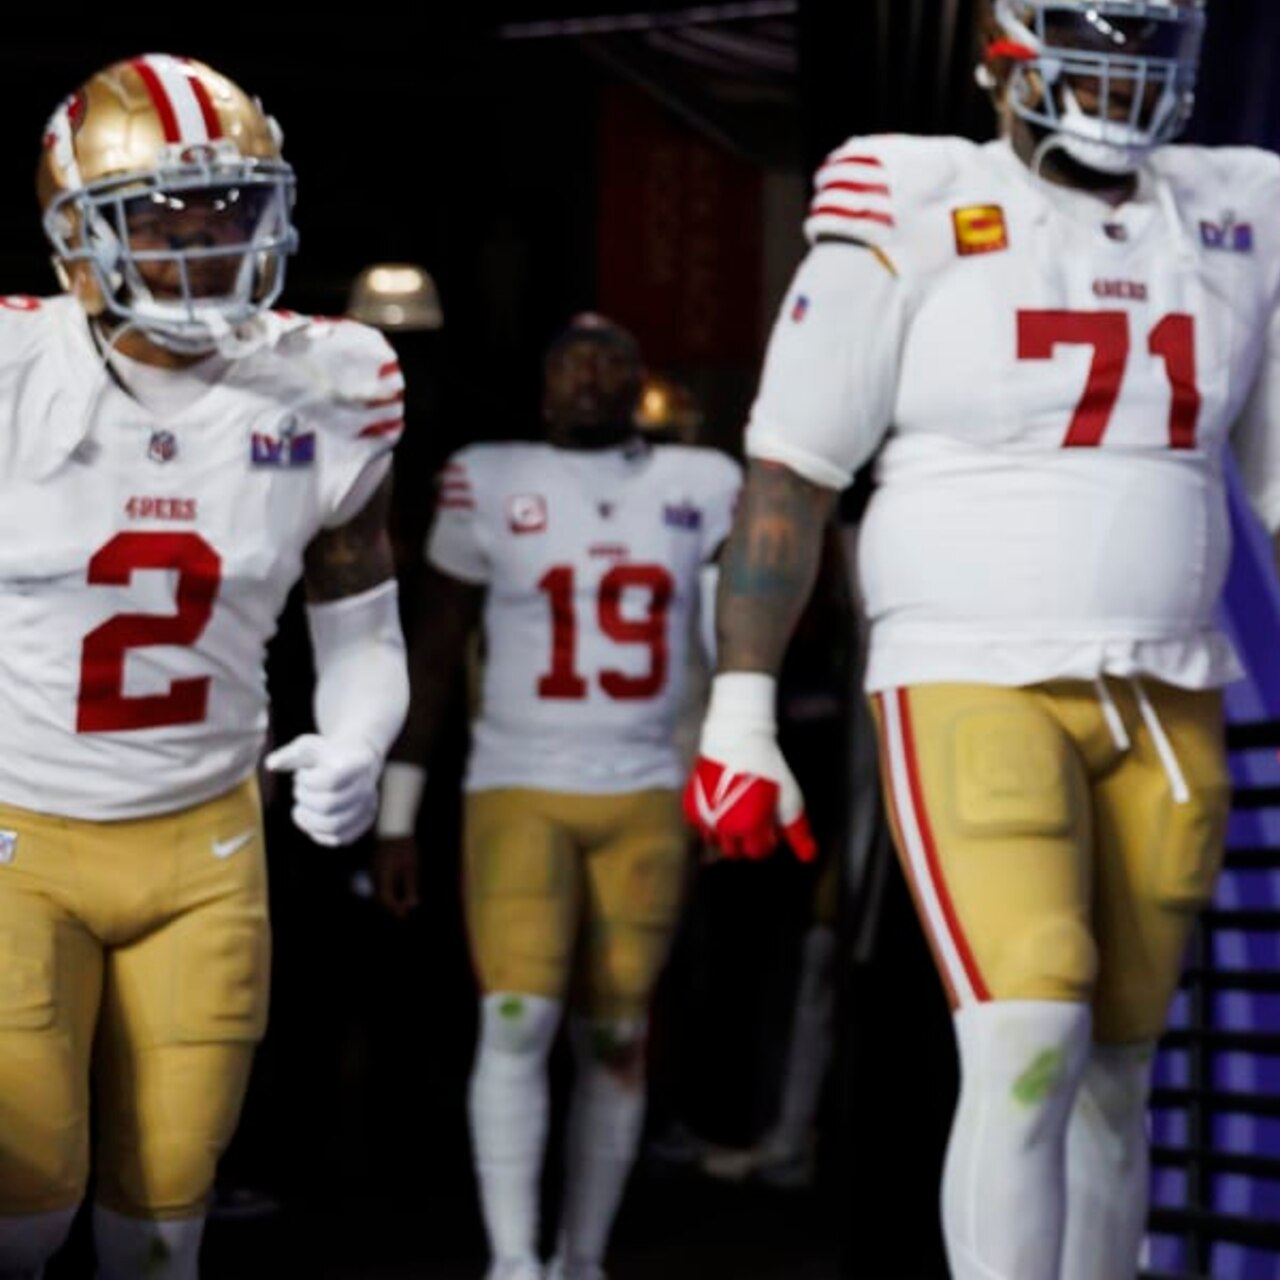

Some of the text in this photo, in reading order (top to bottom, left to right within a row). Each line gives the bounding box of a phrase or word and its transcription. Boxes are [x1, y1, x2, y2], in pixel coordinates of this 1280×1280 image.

[1016, 308, 1201, 450] 71
[76, 530, 222, 733] 2
[537, 563, 674, 701] 19
